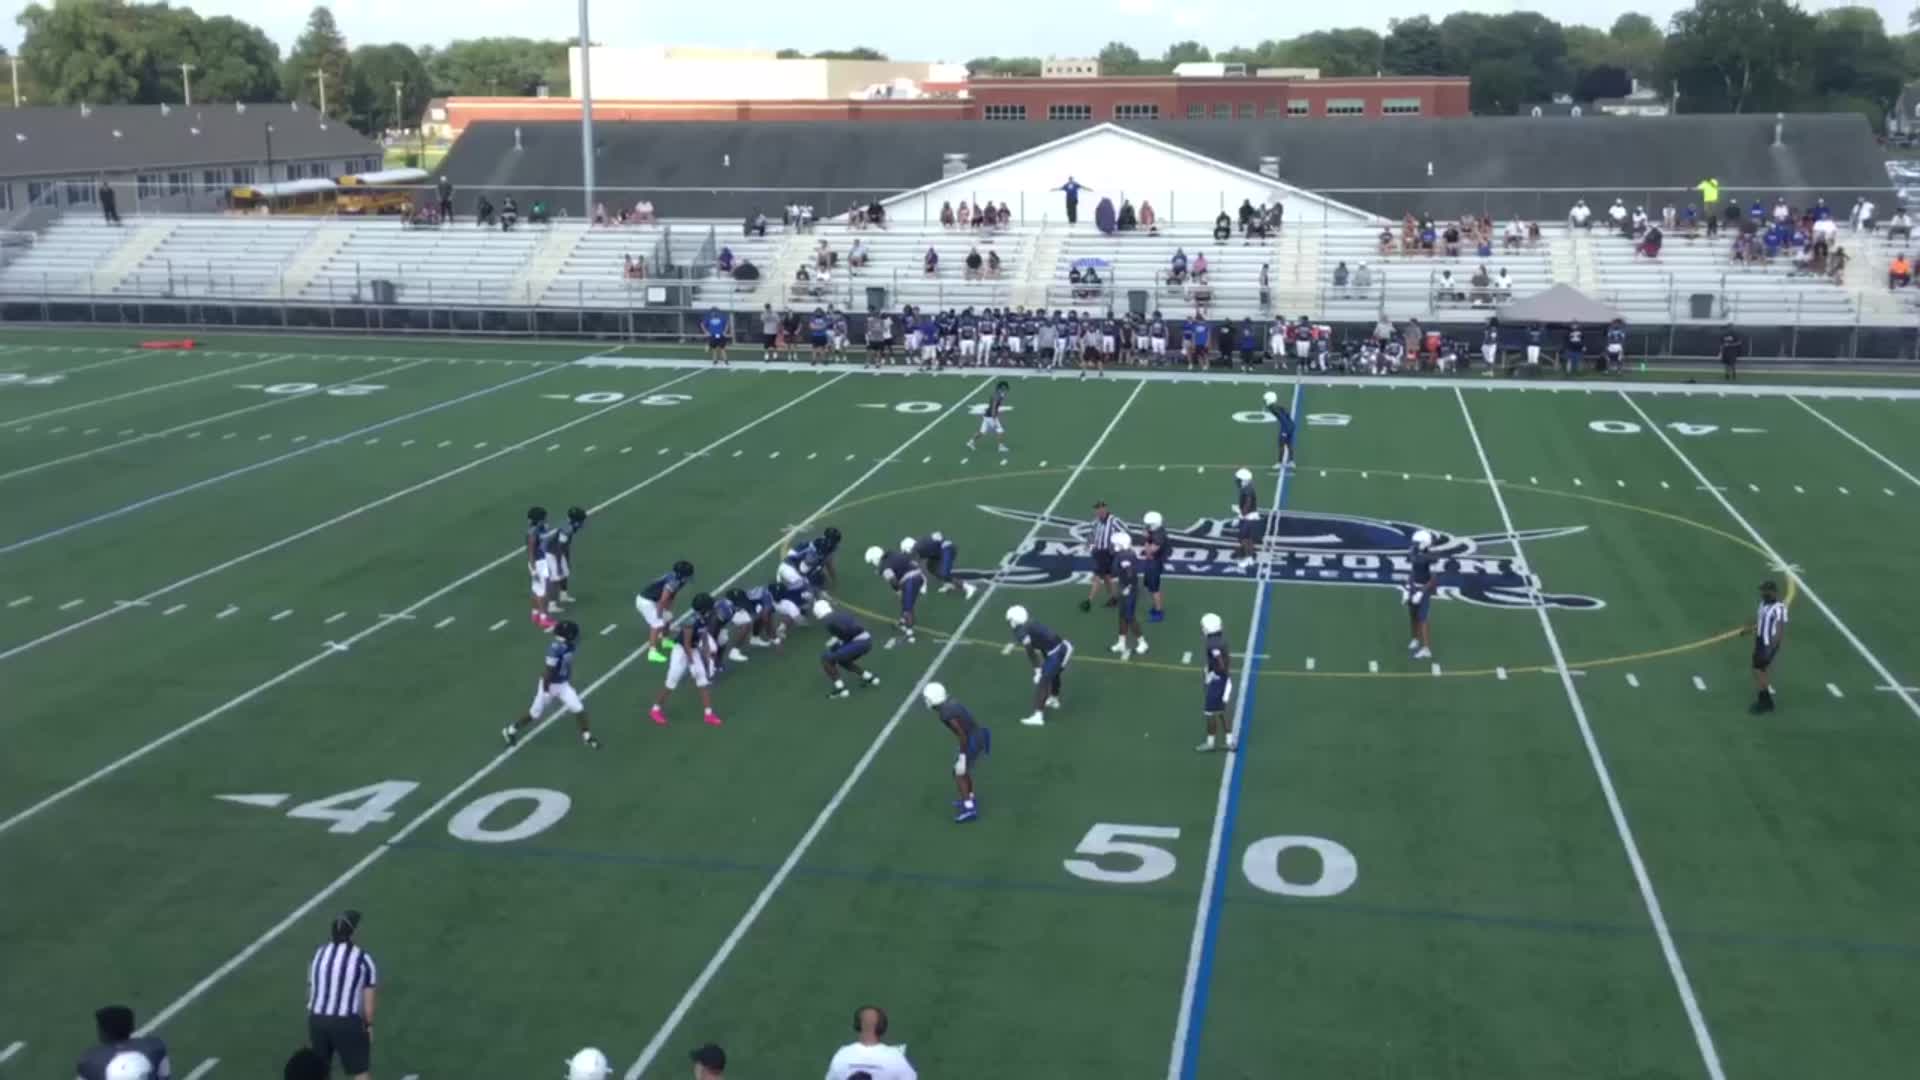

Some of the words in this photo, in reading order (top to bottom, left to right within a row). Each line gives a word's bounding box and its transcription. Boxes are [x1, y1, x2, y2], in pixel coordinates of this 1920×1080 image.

[1588, 420, 1719, 436] 40
[1040, 541, 1504, 576] MDLETOWN
[286, 780, 572, 842] 40
[1063, 822, 1358, 897] 50
